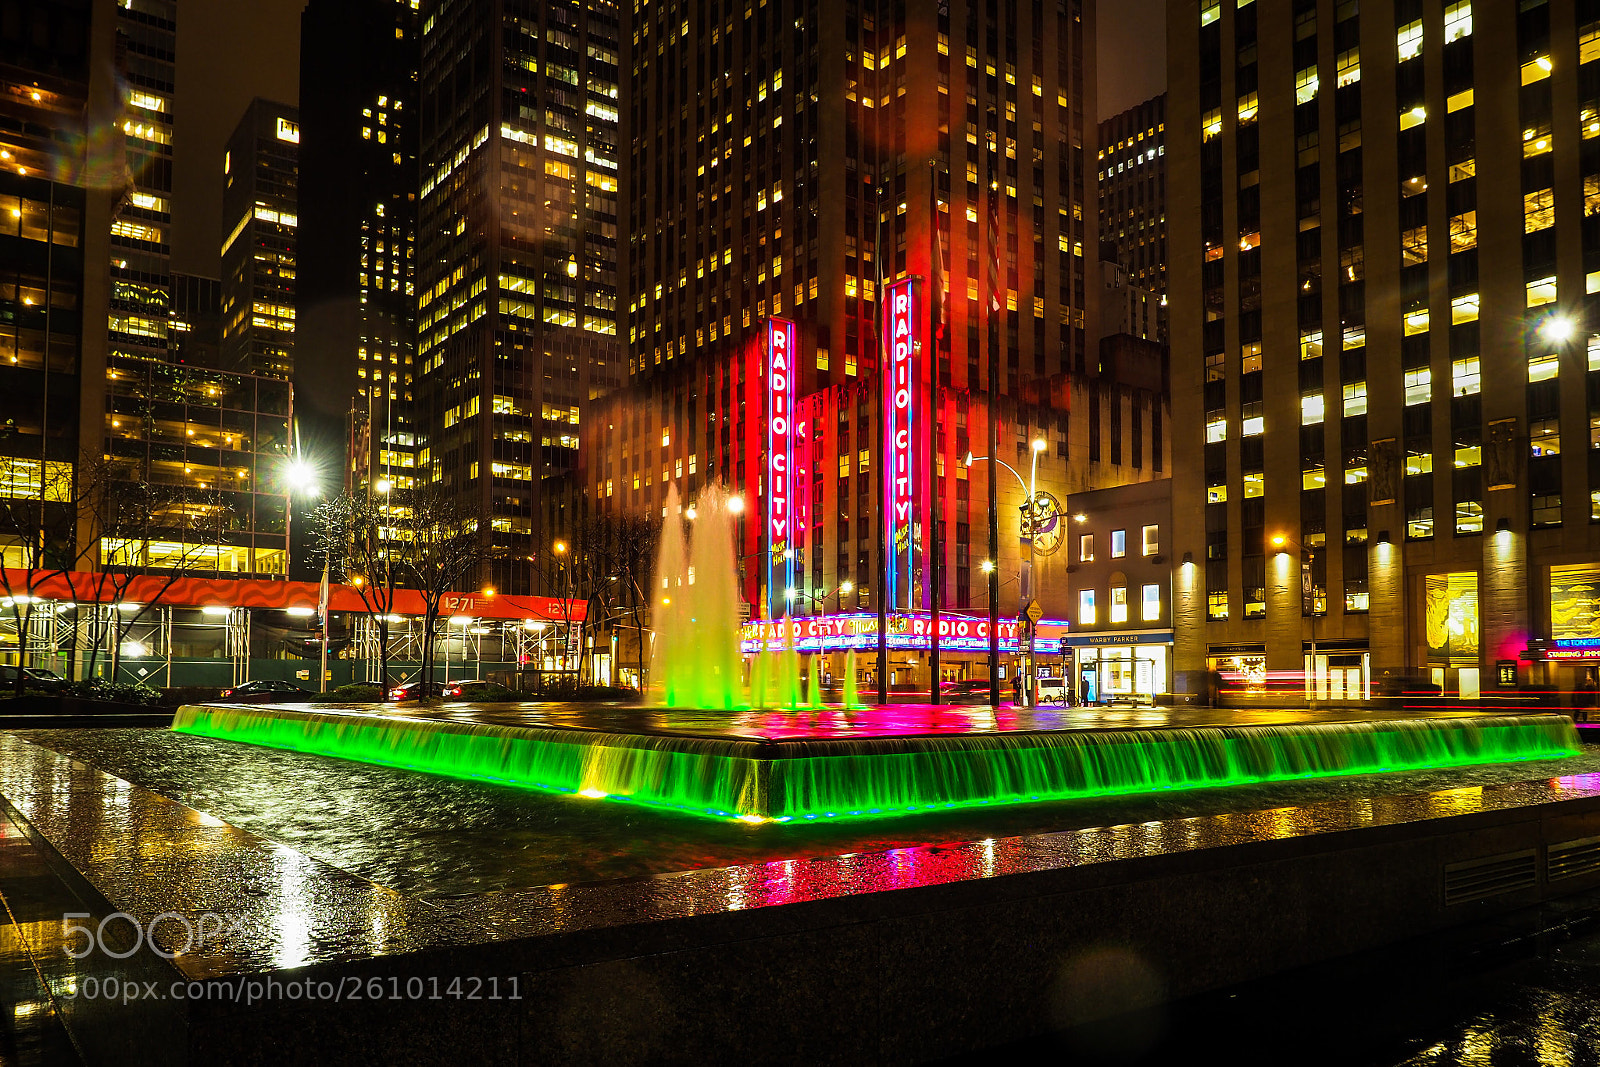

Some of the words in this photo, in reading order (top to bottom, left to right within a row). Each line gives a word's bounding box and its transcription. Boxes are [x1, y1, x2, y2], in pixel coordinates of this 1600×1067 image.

[772, 329, 787, 434] RADIO
[895, 294, 909, 408] RADIO
[772, 453, 786, 537] CITY
[895, 429, 909, 520] CITY
[445, 597, 474, 611] 1271
[759, 622, 802, 638] RADO
[976, 621, 1016, 638] CTY
